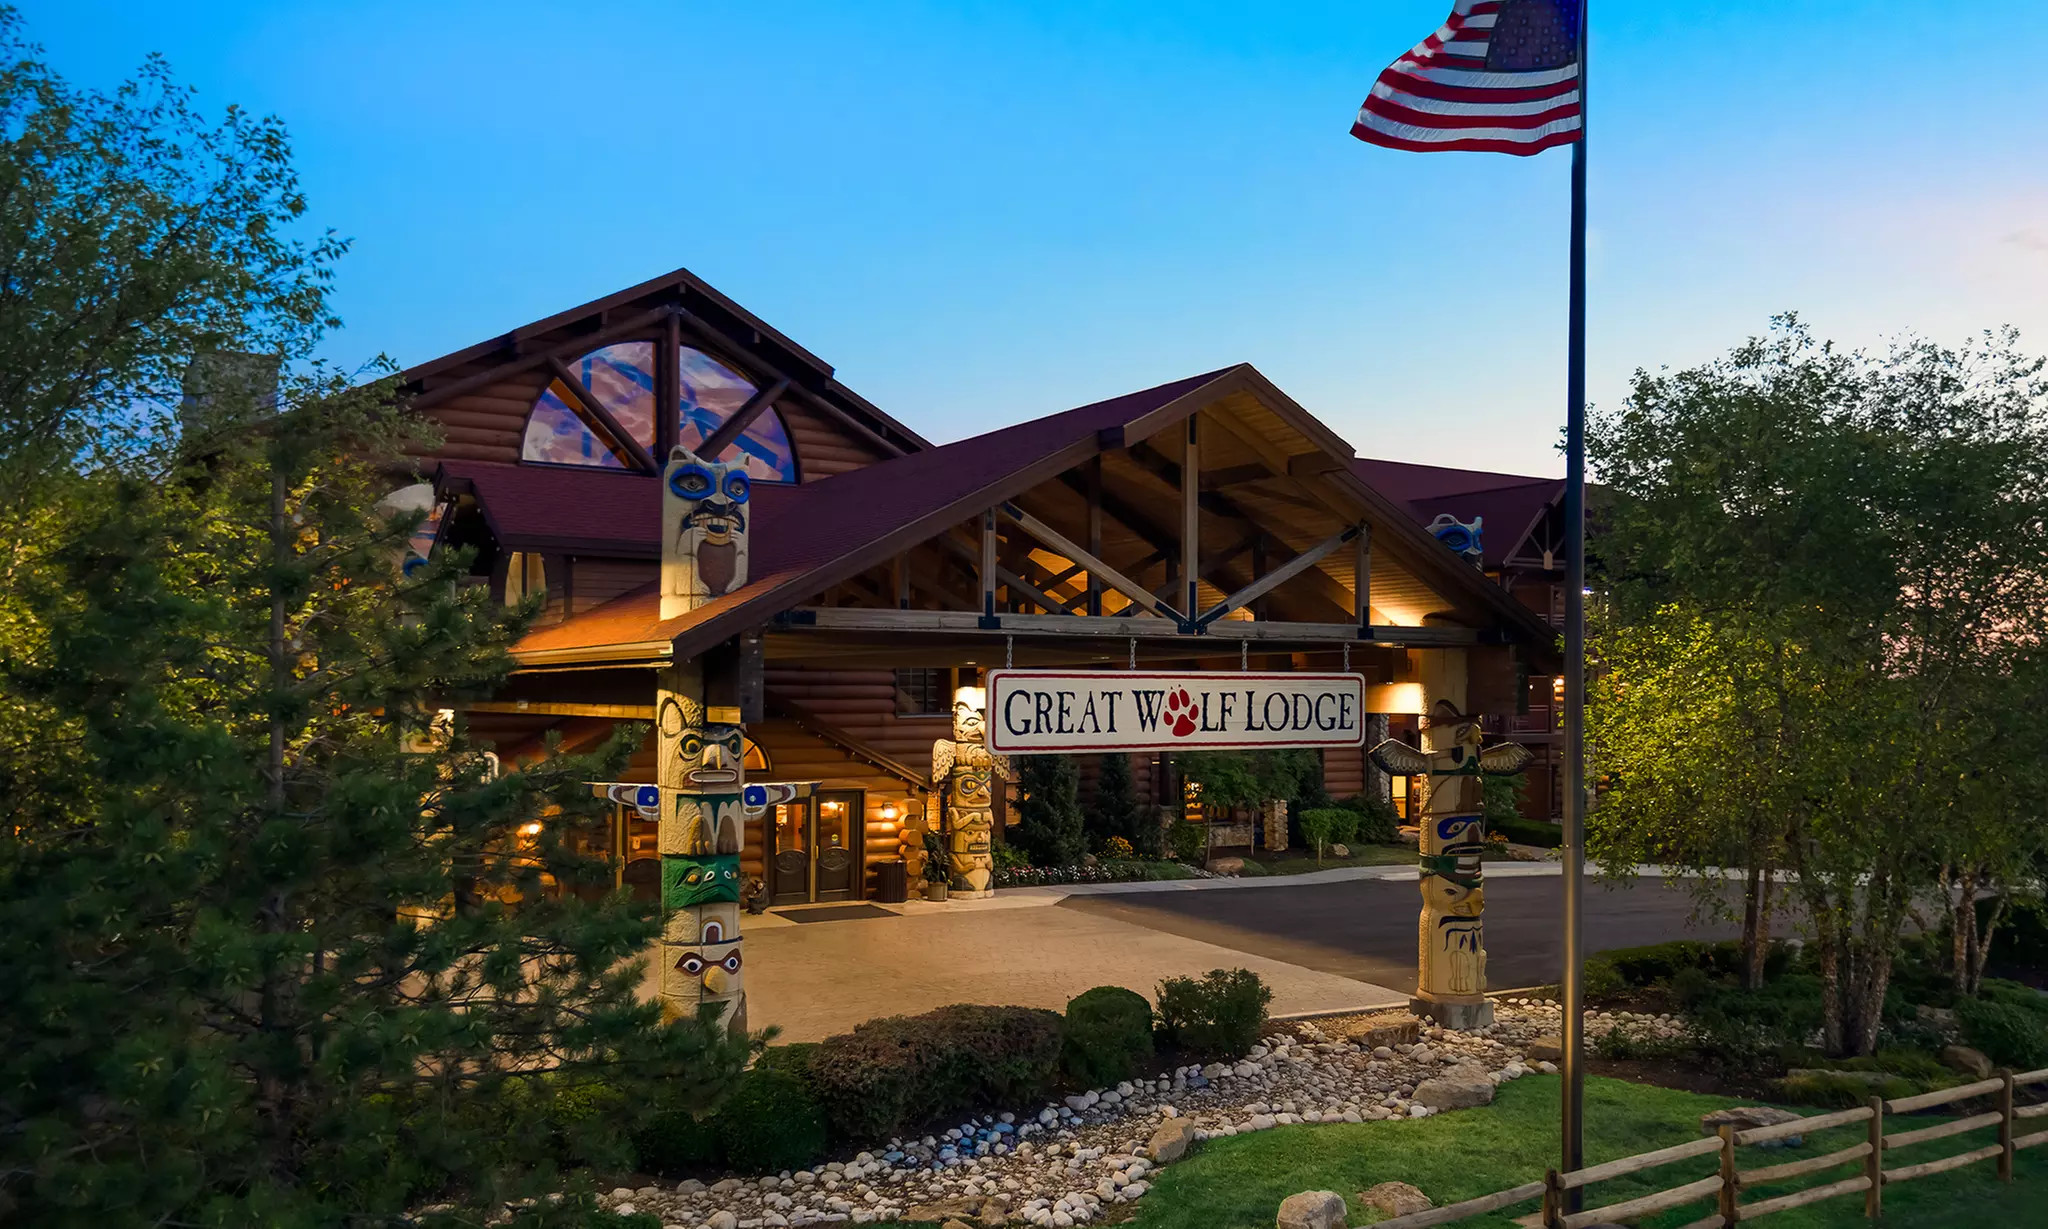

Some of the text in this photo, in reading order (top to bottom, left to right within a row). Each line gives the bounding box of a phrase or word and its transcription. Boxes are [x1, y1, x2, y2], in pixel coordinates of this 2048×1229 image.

[1004, 689, 1357, 737] GREAT WLF LODGE
